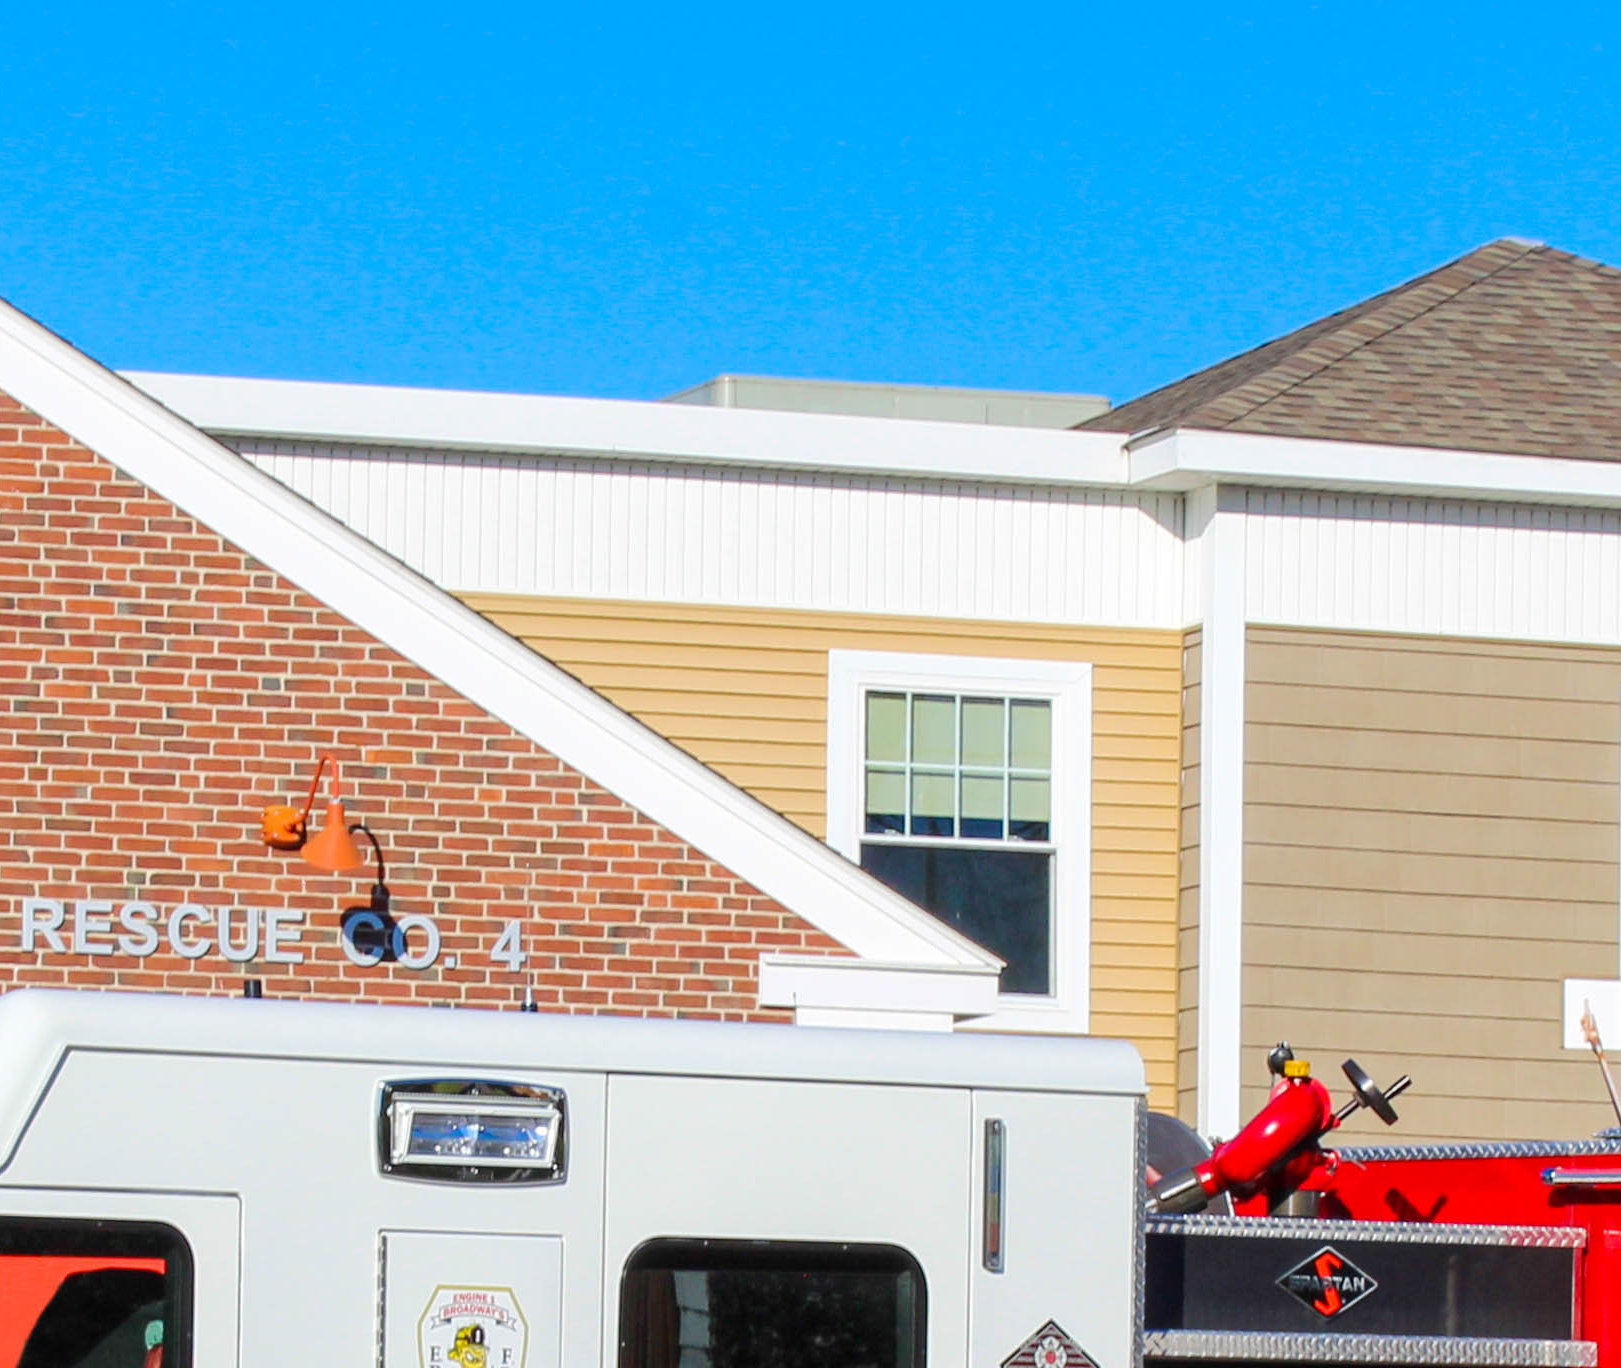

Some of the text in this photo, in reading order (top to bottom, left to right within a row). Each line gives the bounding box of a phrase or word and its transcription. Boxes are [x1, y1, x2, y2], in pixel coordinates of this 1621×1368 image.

[21, 899, 527, 972] RESCUE CO. 4
[453, 1292, 488, 1304] ENGINE
